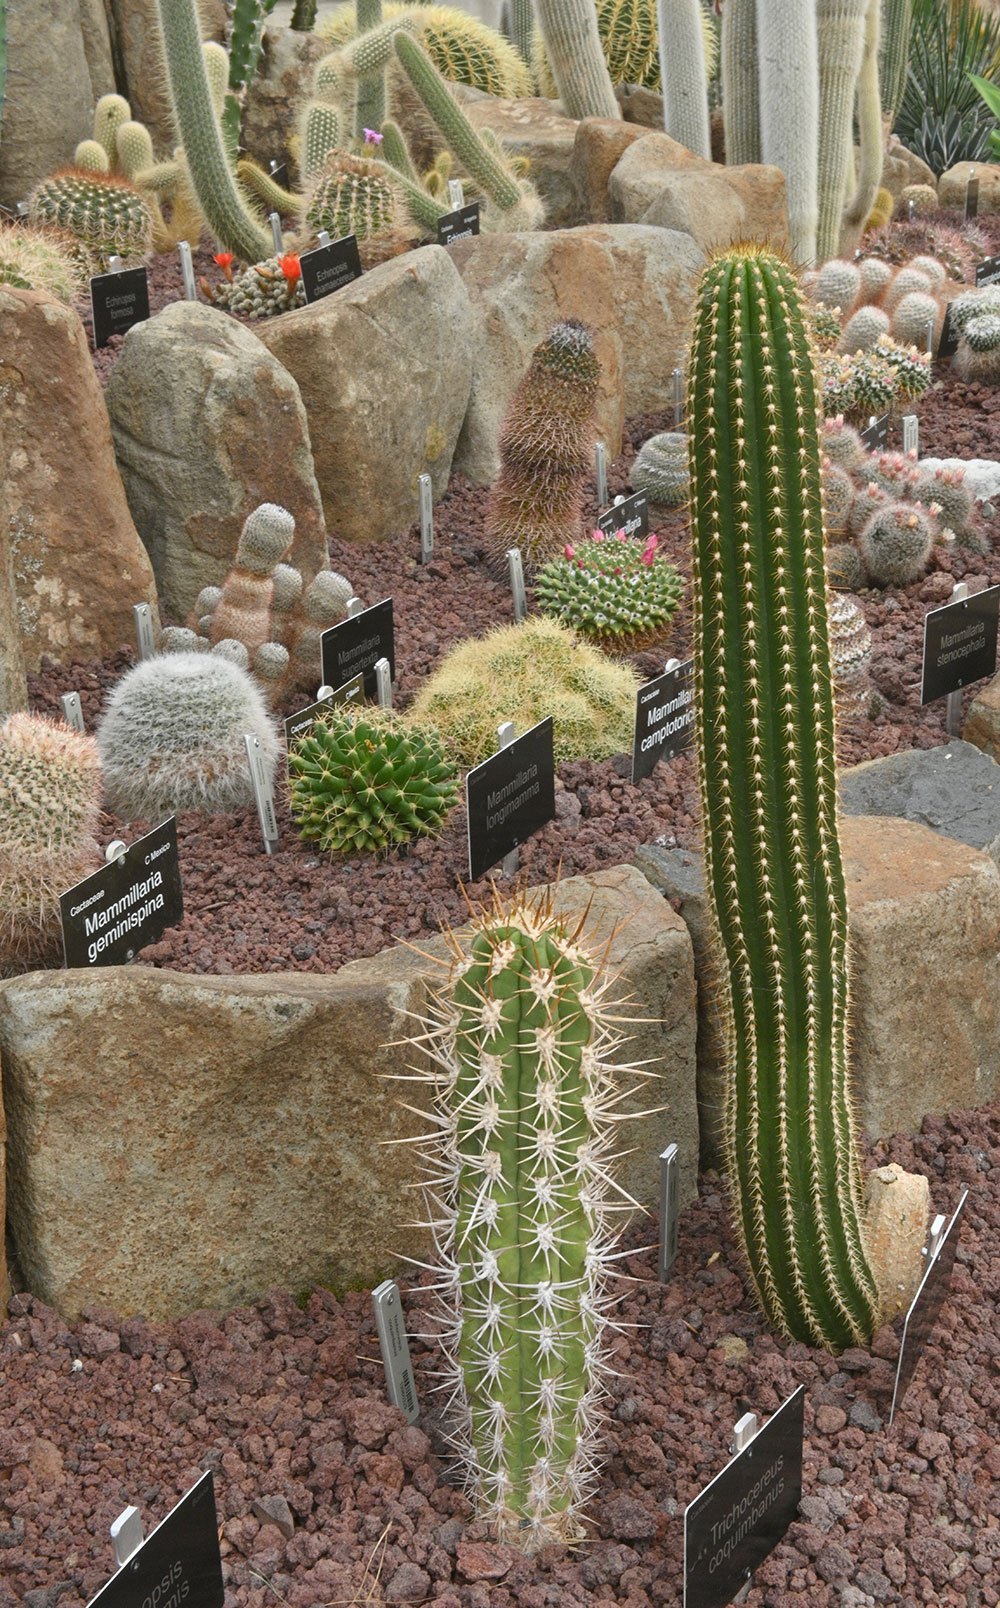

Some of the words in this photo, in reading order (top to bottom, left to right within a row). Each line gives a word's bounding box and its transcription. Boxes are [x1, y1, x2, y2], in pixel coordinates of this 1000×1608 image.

[338, 635, 380, 665] Mammillaria
[937, 636, 986, 667] stenocephala
[941, 621, 984, 649] Mammillaria
[486, 763, 539, 811] Mammillaria
[486, 780, 540, 831] longimamma
[144, 855, 151, 866] C
[151, 842, 171, 861] Mexico
[70, 889, 106, 918] Cactaceae
[85, 870, 164, 937] Mammillaria
[87, 892, 165, 963] geminispina
[710, 1454, 784, 1546] Trichocereus
[708, 1477, 785, 1574] coquimbanus
[141, 1560, 183, 1608] opsis
